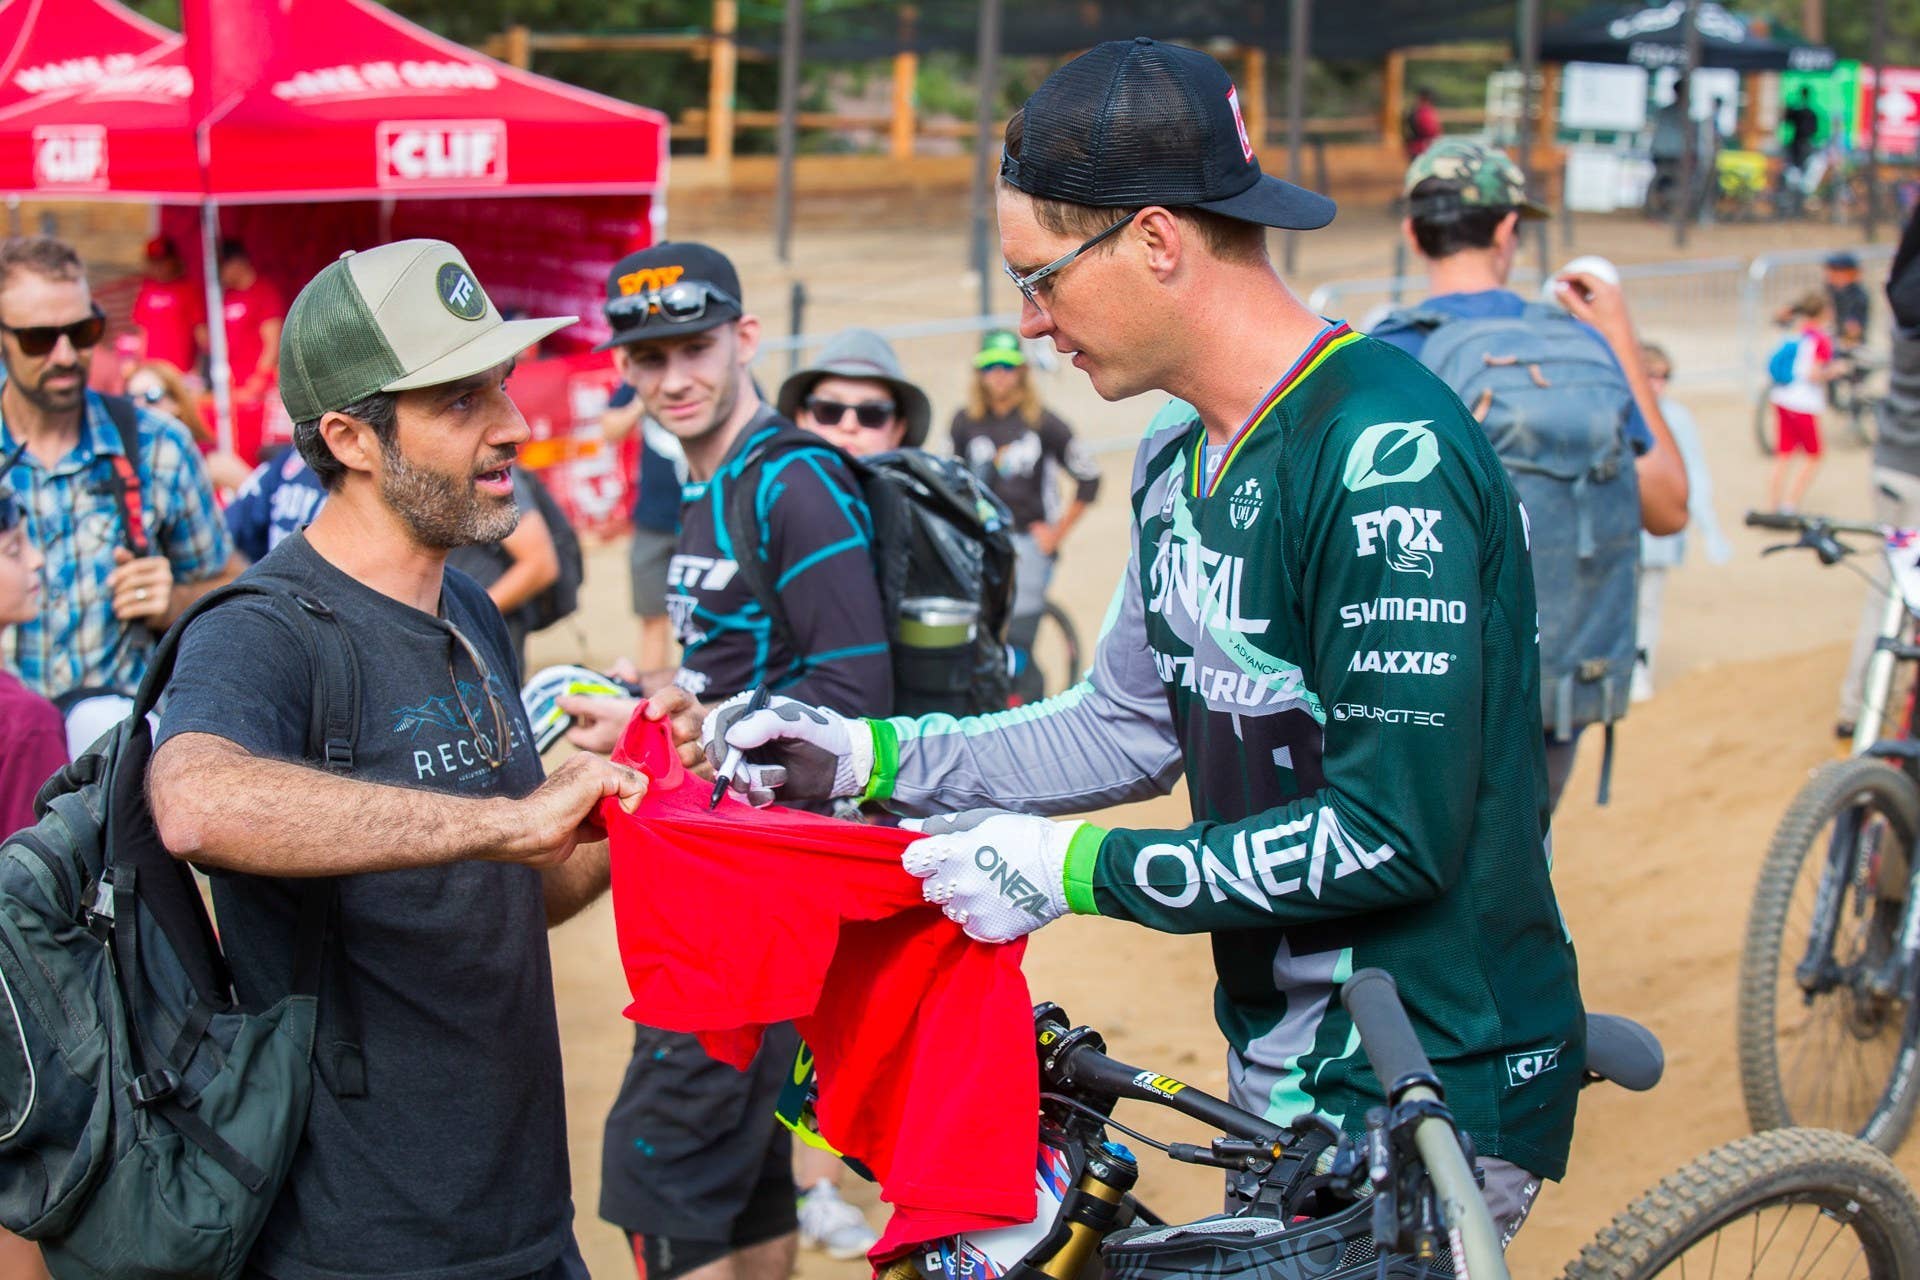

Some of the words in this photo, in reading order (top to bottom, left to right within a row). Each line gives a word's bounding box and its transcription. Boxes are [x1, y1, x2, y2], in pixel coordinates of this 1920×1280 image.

[391, 130, 497, 180] CLIF
[1352, 505, 1443, 570] FOX
[1234, 643, 1284, 675] ADVANCE
[1202, 666, 1302, 707] CRUZ
[1351, 703, 1446, 727] BURGTEC
[413, 717, 528, 780] RECOR
